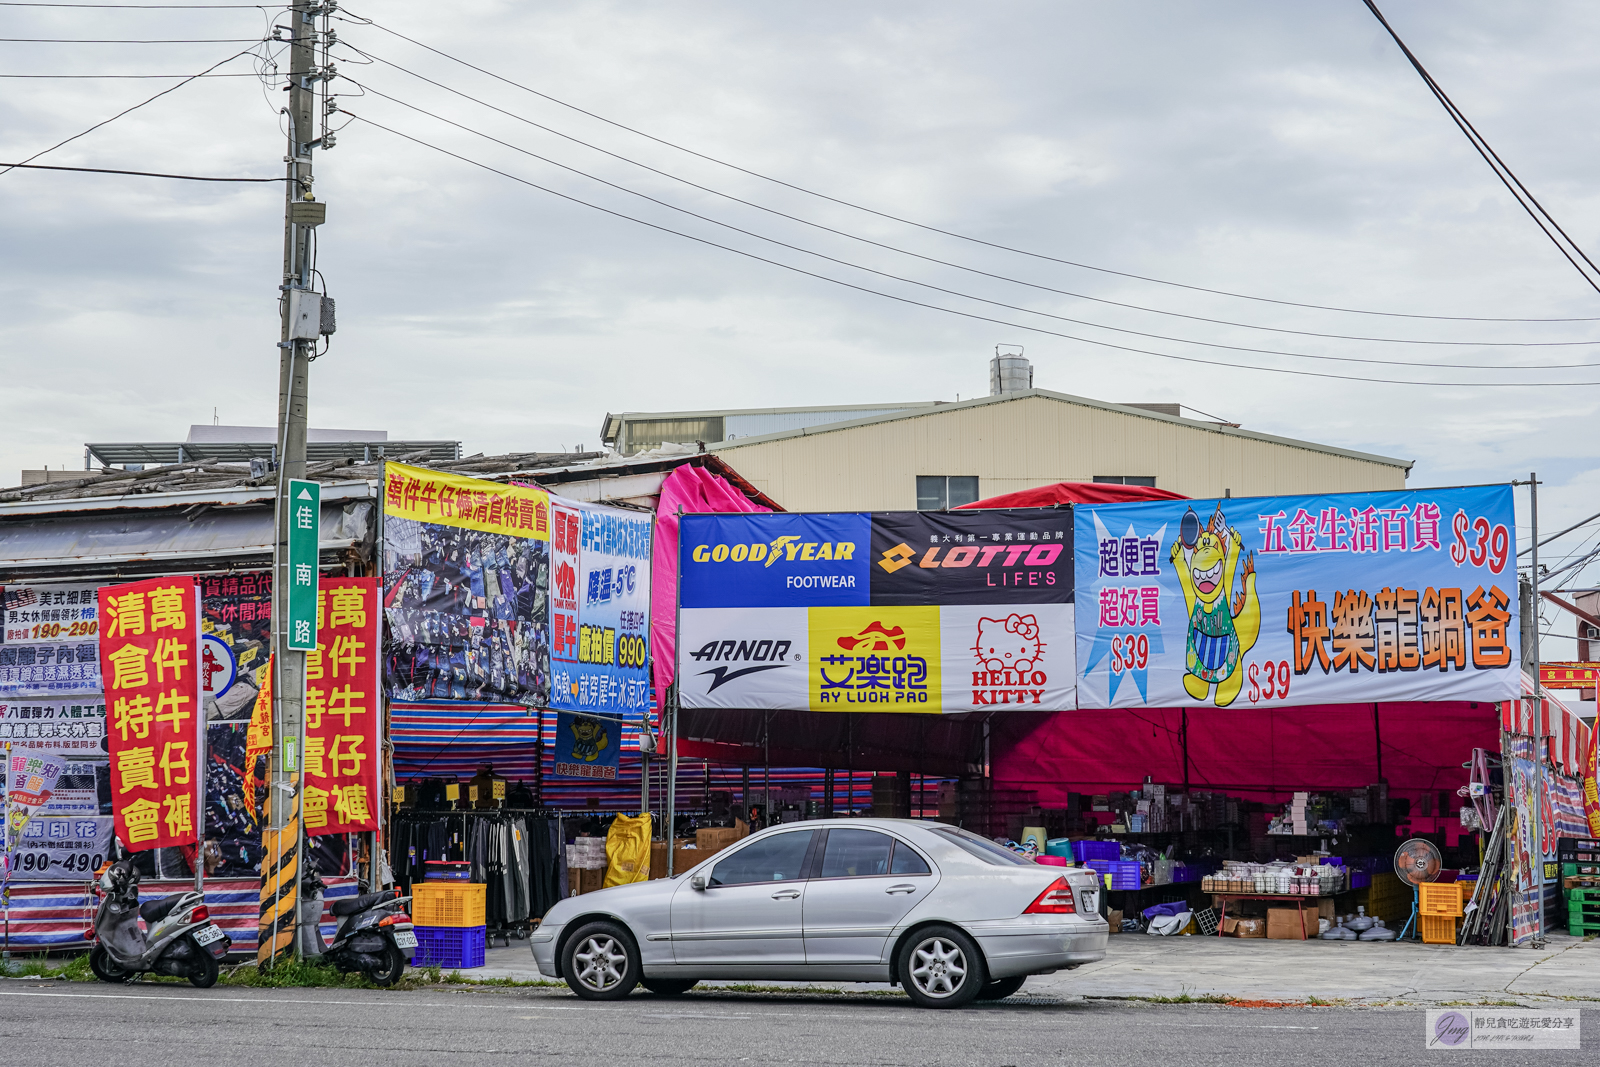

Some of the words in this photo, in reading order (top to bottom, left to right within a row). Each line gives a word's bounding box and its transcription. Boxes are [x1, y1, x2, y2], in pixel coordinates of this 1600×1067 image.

[386, 472, 547, 533] 萬件牛仔褲清倉特賣會
[554, 511, 579, 556] 原廠
[930, 531, 1064, 543] 義大利第一專業運動品牌
[1258, 502, 1441, 554] 五金生活百貨
[1451, 508, 1510, 575] $39
[692, 541, 856, 563] GOODYEAR
[919, 544, 1064, 568] LOTTO
[1099, 536, 1160, 578] 超便宜
[198, 574, 272, 597] 貨精品代
[295, 505, 313, 644] 佳南路
[786, 575, 856, 588] FOOTWEAR
[987, 571, 1056, 587] LIFE'S
[221, 602, 272, 622] 休閒褲
[1099, 587, 1160, 627] 超好買
[32, 621, 98, 639] 190~290
[554, 613, 576, 657] 犀牛
[1287, 585, 1511, 674] 快樂龍鍋爸
[618, 633, 646, 669] 990
[689, 640, 792, 662] ARNOR
[1112, 634, 1149, 675] $39
[972, 670, 1047, 686] HELLO
[1248, 660, 1291, 705] $39
[328, 585, 371, 824] 萬件牛仔褲
[820, 692, 840, 702] AY
[972, 689, 1045, 704] KITTY
[7, 706, 55, 719] 八面彈力
[106, 592, 161, 844] 清倉特賣會
[147, 585, 193, 837] 萬件牛仔褲
[556, 762, 616, 779] 快樂龍鍋爸
[13, 852, 103, 872] 190~490
